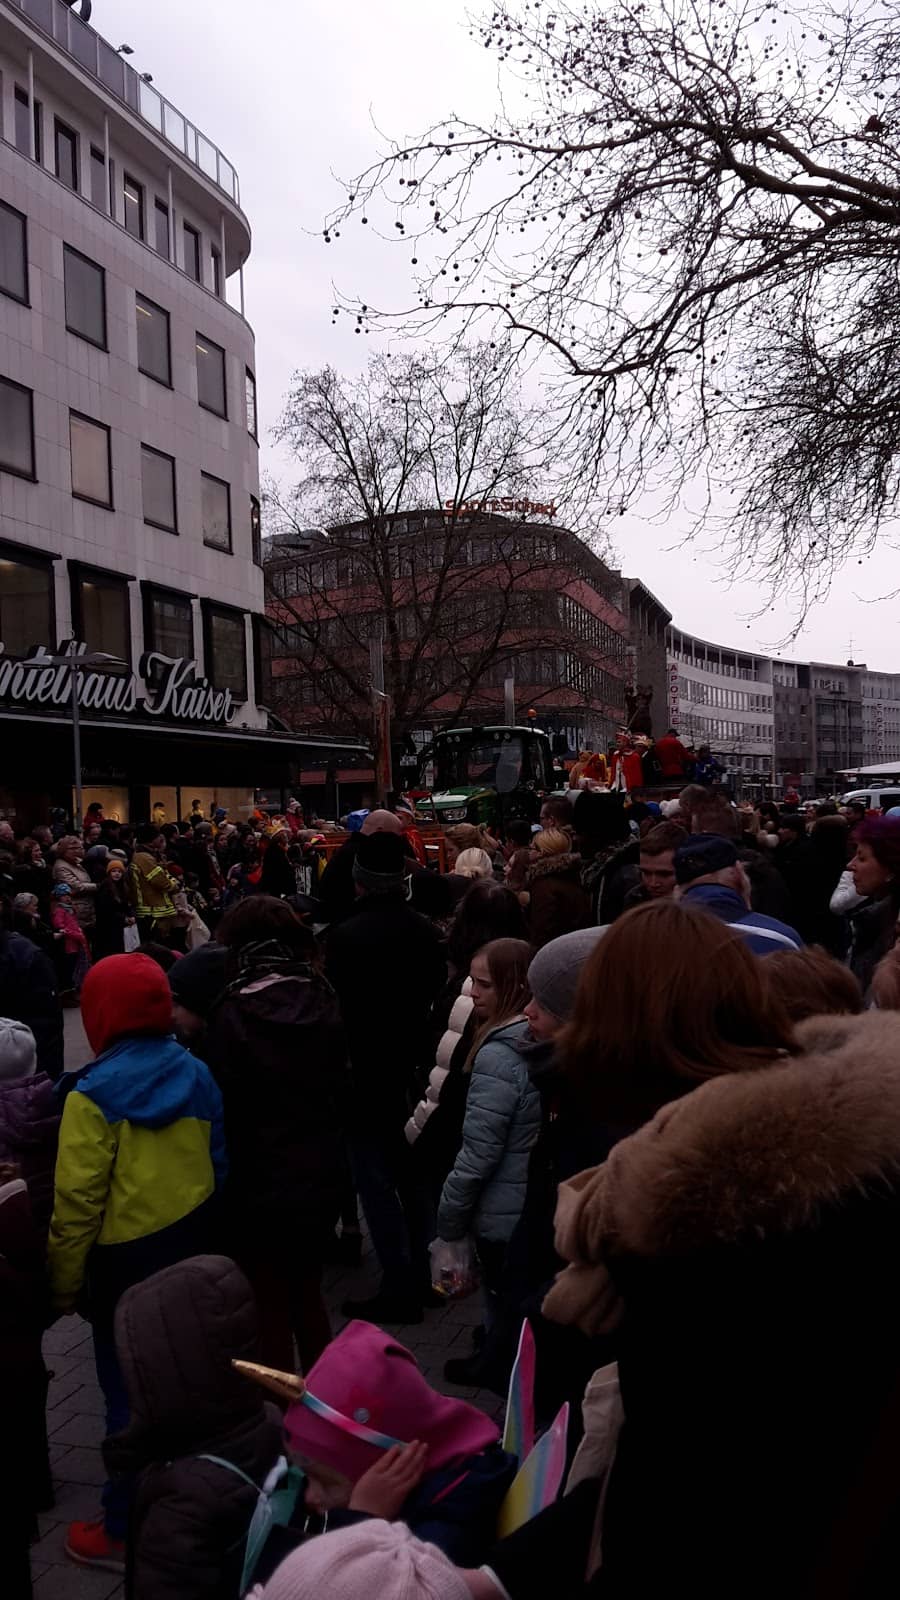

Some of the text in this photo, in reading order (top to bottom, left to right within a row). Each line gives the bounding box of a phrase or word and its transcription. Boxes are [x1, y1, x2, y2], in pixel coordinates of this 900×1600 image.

[0, 640, 237, 723] ntelhaus Kaiser
[670, 664, 680, 725] APOTHE
